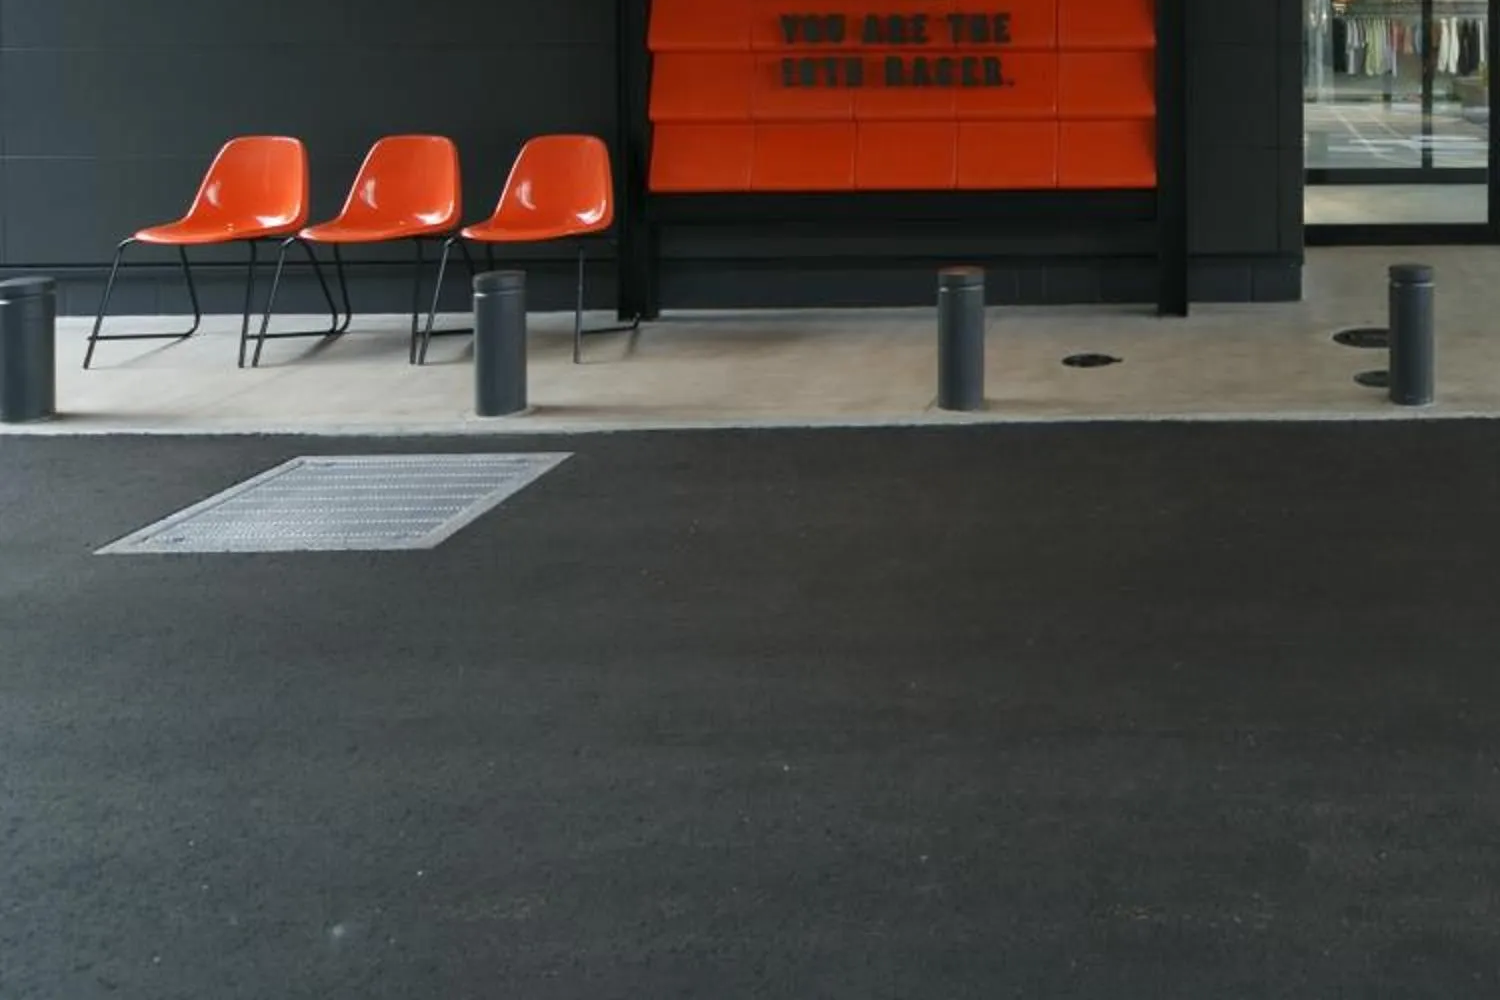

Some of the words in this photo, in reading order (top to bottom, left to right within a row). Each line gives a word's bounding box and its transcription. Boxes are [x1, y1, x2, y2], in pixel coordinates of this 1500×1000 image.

[780, 13, 846, 44] YOU
[861, 13, 929, 44] ARE
[946, 13, 1012, 45] THE
